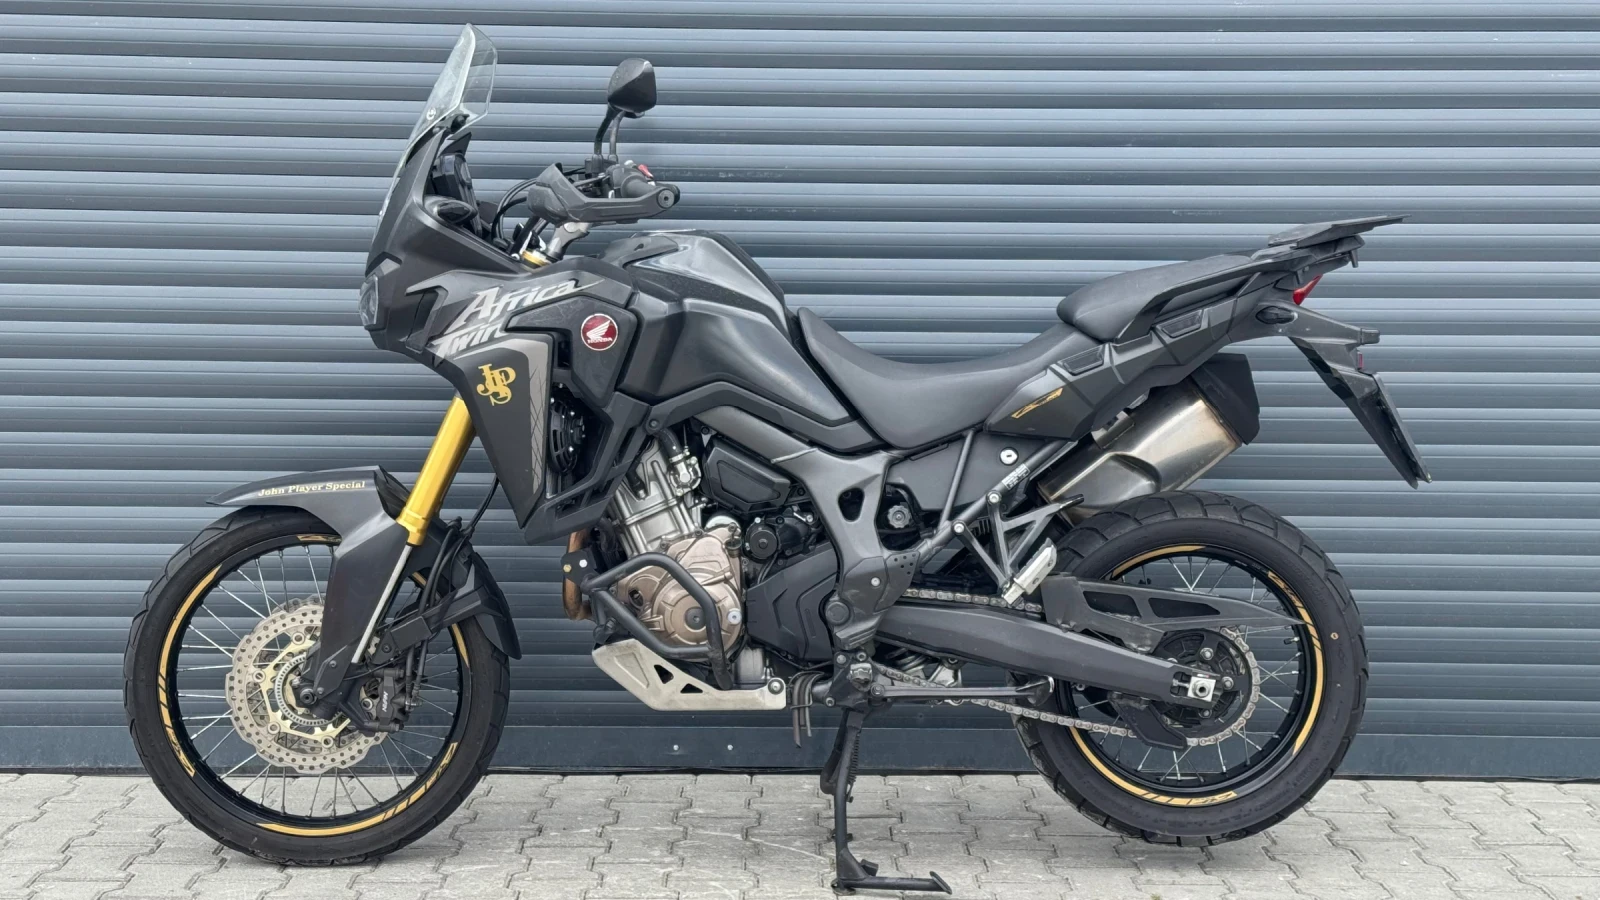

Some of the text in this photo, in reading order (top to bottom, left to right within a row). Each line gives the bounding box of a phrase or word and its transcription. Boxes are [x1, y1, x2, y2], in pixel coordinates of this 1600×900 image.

[445, 278, 605, 334] Africa
[433, 321, 510, 362] Twin
[587, 336, 613, 344] HONDA
[258, 481, 366, 497] John Player Special
